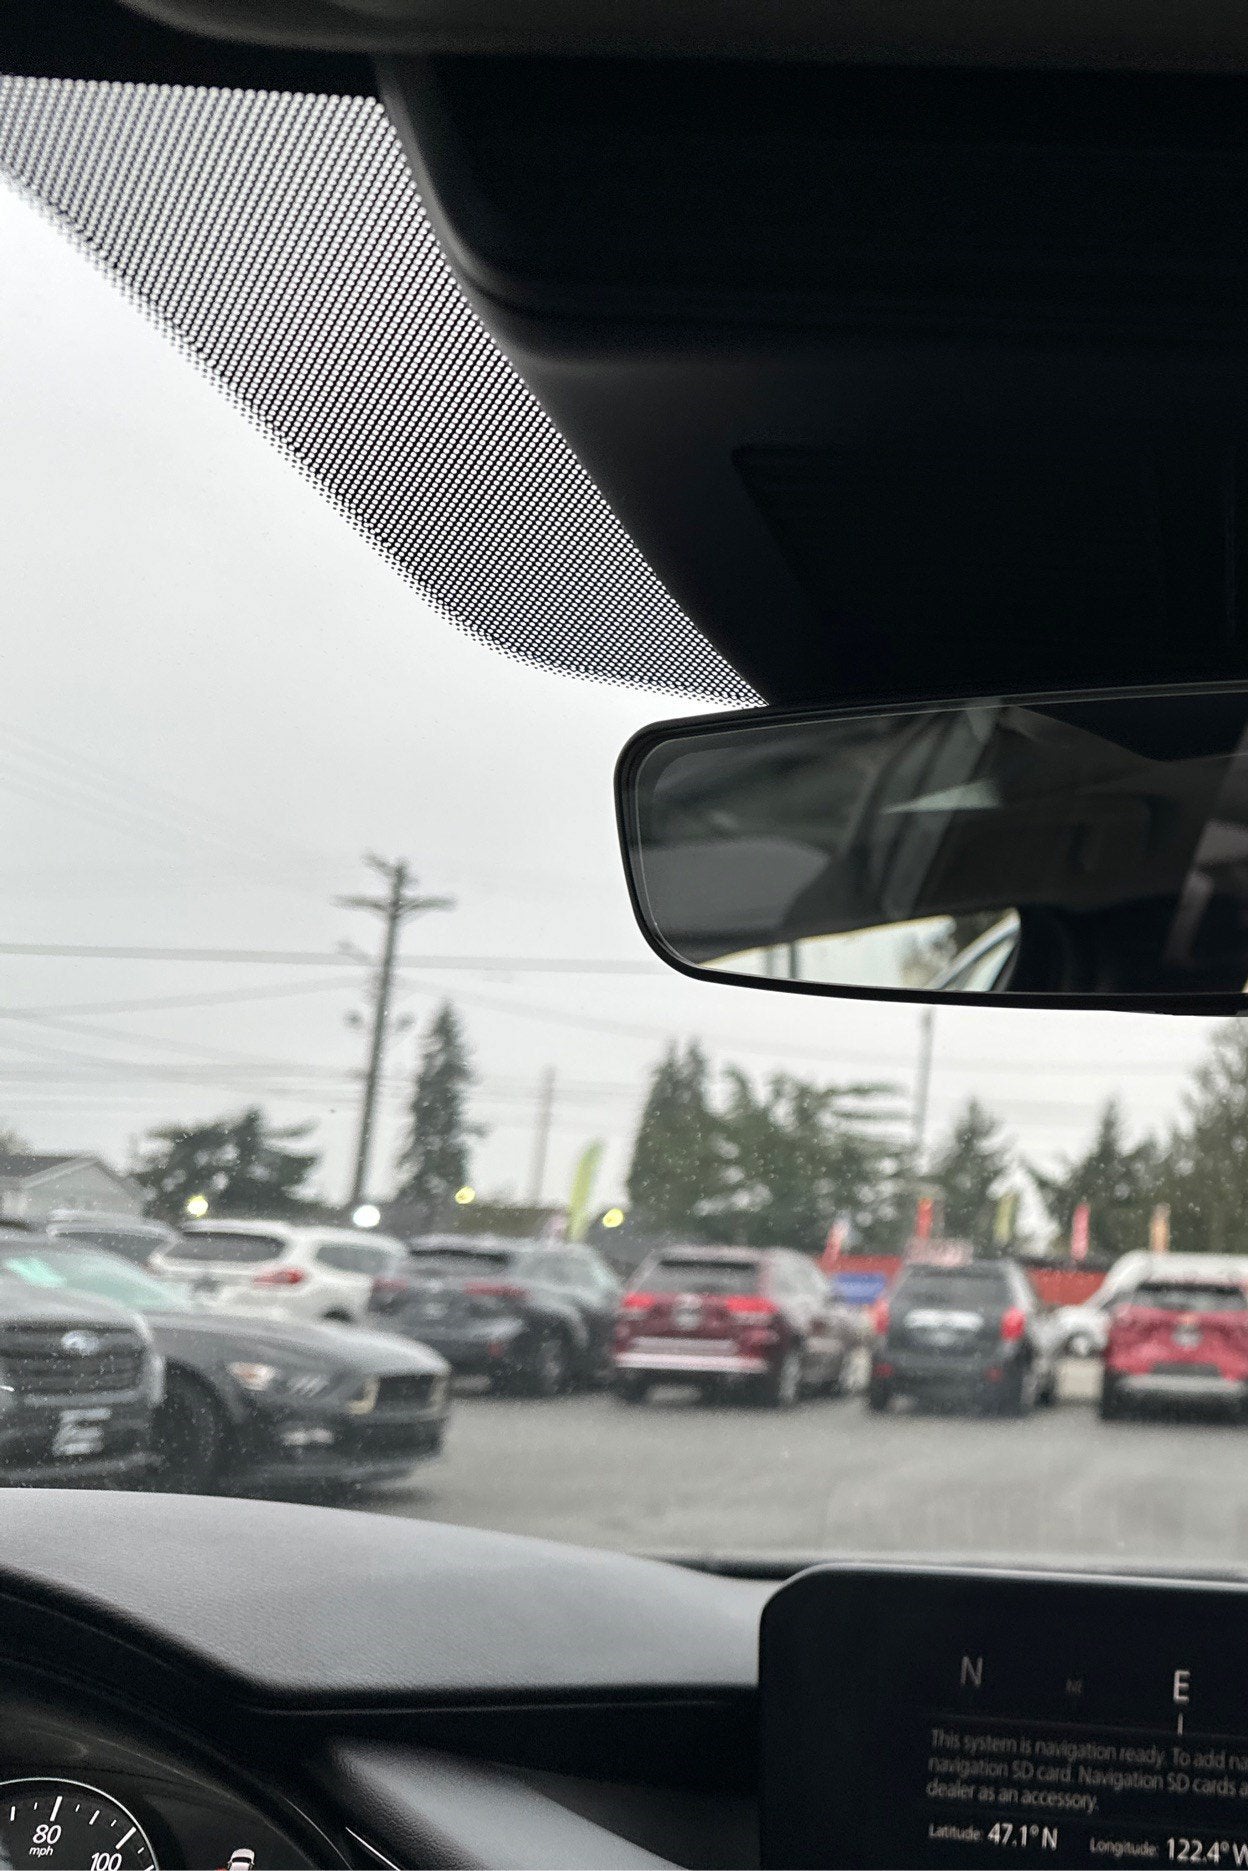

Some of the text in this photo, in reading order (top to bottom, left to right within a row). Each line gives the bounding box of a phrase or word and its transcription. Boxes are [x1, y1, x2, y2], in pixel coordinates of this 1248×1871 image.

[960, 1655, 983, 1688] N
[1172, 1669, 1191, 1703] E
[931, 1727, 960, 1749] This
[963, 1733, 1018, 1755] system
[1020, 1736, 1032, 1756] is
[1035, 1739, 1117, 1763] navigation
[1172, 1747, 1191, 1768] To
[1193, 1749, 1226, 1770] add
[926, 1777, 975, 1799] dealer
[977, 1788, 996, 1802] as
[998, 1787, 1019, 1804] an
[928, 1756, 1009, 1779] navigation
[1012, 1759, 1035, 1781] SD
[1078, 1764, 1165, 1792] Navigation
[1167, 1771, 1191, 1794] SD
[1193, 1774, 1236, 1798] cards
[32, 1824, 62, 1845] 80
[29, 1845, 54, 1857] mph
[90, 1852, 122, 1870] 100
